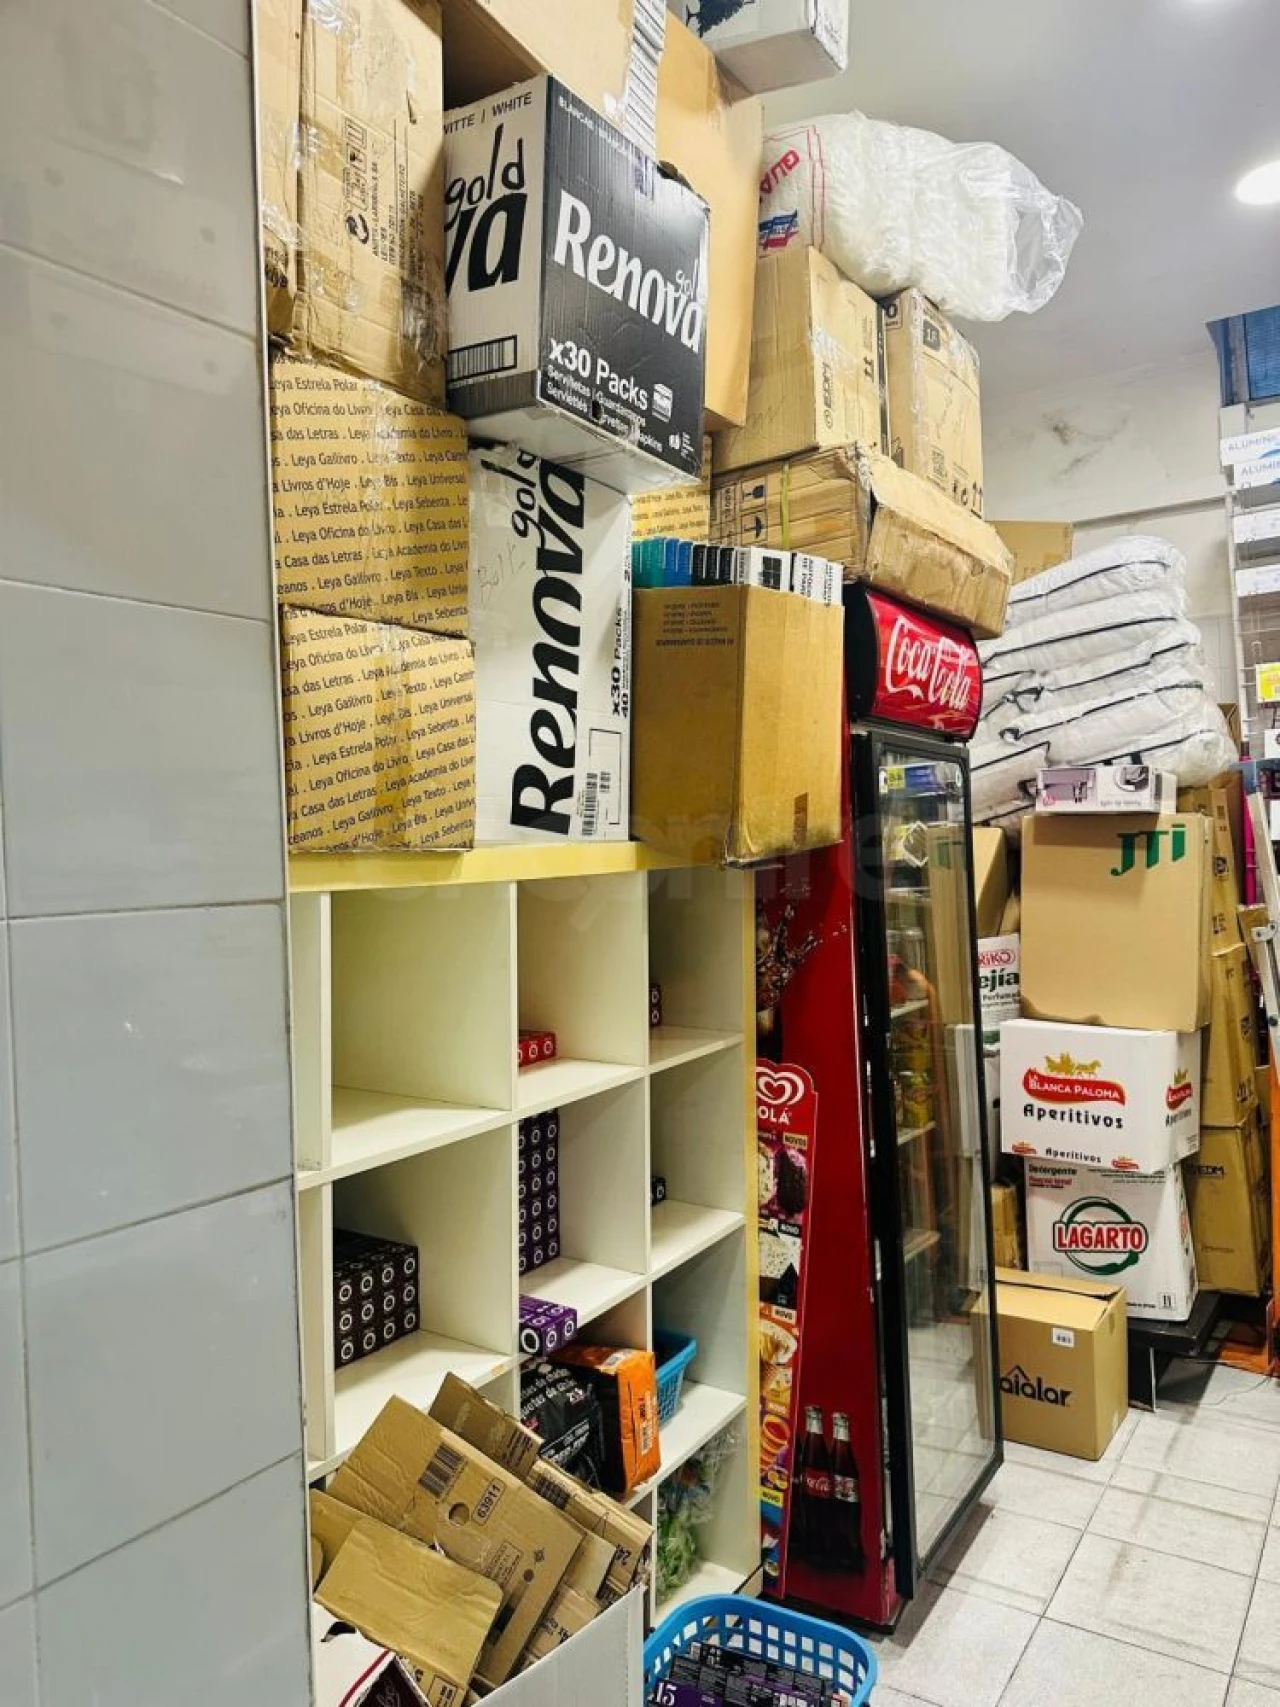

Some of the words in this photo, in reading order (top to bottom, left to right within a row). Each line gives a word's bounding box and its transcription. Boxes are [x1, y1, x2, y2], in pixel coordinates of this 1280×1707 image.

[492, 92, 532, 116] WHITE
[444, 124, 525, 232] gold
[554, 189, 706, 355] Renova
[295, 377, 331, 390] Estrela
[333, 379, 358, 391] Polar
[549, 338, 591, 378] x30
[597, 357, 648, 411] Packs
[293, 402, 330, 416] Oficina
[332, 402, 346, 415] do
[403, 403, 424, 416] Casa
[286, 427, 304, 440] das
[306, 427, 339, 441] Letras
[350, 427, 370, 440] Leya
[419, 428, 431, 439] do
[292, 455, 317, 469] Leya
[424, 453, 446, 464] Leya
[283, 479, 315, 492] Livros
[384, 475, 399, 487] Bis
[408, 475, 428, 488] Leya
[429, 473, 466, 484] Universal
[295, 505, 320, 518] Leya
[323, 502, 358, 514] Estrela
[393, 499, 414, 510] Leya
[416, 497, 450, 508] Sebenta
[291, 529, 317, 543] Leya
[319, 526, 355, 540] Oficina
[358, 524, 370, 536] do
[403, 521, 425, 533] Leya
[426, 518, 447, 530] Casa
[448, 518, 462, 529] das
[284, 554, 310, 567] Casa
[312, 552, 330, 566] das
[331, 550, 363, 564] Letras
[396, 543, 438, 558] Academia
[439, 542, 452, 553] do
[317, 576, 342, 590] Leya
[390, 569, 412, 582] Leya
[414, 566, 437, 578] Texto
[445, 564, 464, 575] Leya
[382, 594, 404, 609] Leya
[406, 588, 420, 602] Bis
[426, 587, 448, 600] Leya
[412, 611, 433, 624] Leya
[308, 628, 342, 642] Estrela
[344, 623, 367, 635] Polar
[612, 606, 622, 661] Packs
[308, 651, 344, 667] Oficina
[345, 648, 359, 659] do
[411, 635, 432, 648] Casa
[510, 458, 586, 836] Renova
[302, 680, 322, 692] das
[322, 673, 354, 688] Letras
[362, 667, 385, 681] Leya
[428, 655, 440, 667] do
[440, 650, 460, 664] Livro
[308, 702, 333, 718] Leya
[404, 681, 427, 695] Texto
[435, 675, 452, 689] Leya
[611, 665, 621, 718] x30
[298, 729, 332, 743] Livros
[420, 701, 438, 715] Leya
[439, 693, 473, 707] Universal
[312, 752, 337, 766] Leya
[339, 743, 373, 759] Estrela
[375, 735, 397, 749] Polar
[406, 727, 426, 740] Leya
[427, 718, 460, 734] Sebenta
[309, 777, 334, 791] Leya
[336, 766, 371, 784] Oficina
[373, 761, 385, 773] do
[386, 754, 409, 769] Livro
[416, 747, 436, 760] Leya
[436, 740, 456, 754] Casa
[457, 735, 470, 748] das
[301, 804, 325, 818] Casa
[327, 797, 346, 809] das
[347, 786, 378, 803] Letras
[385, 776, 407, 792] Leya
[408, 764, 448, 784] Academia
[449, 760, 461, 772] do
[332, 815, 356, 832] Leya
[403, 794, 422, 809] Leya
[423, 787, 446, 801] Texto
[453, 779, 472, 792] Leya
[392, 818, 413, 834] Leya
[414, 813, 428, 826] Bis
[435, 804, 454, 819] Leya
[421, 830, 441, 845] Leya
[980, 967, 1020, 992] ejía
[1029, 1079, 1072, 1094] BLANCA
[1074, 1085, 1121, 1099] PALOMA
[758, 1105, 790, 1126] OLÁ
[1023, 1104, 1124, 1129] Aperitivos
[784, 1136, 807, 1147] NOVOS
[1045, 1147, 1102, 1164] Aperitivos
[1029, 1164, 1077, 1176] Detergente
[781, 1224, 800, 1234] NOVO
[1056, 1223, 1145, 1251] LAGARTO
[774, 1309, 794, 1320] NOVO
[477, 1483, 502, 1518] 63911
[658, 1682, 677, 1707] 15
